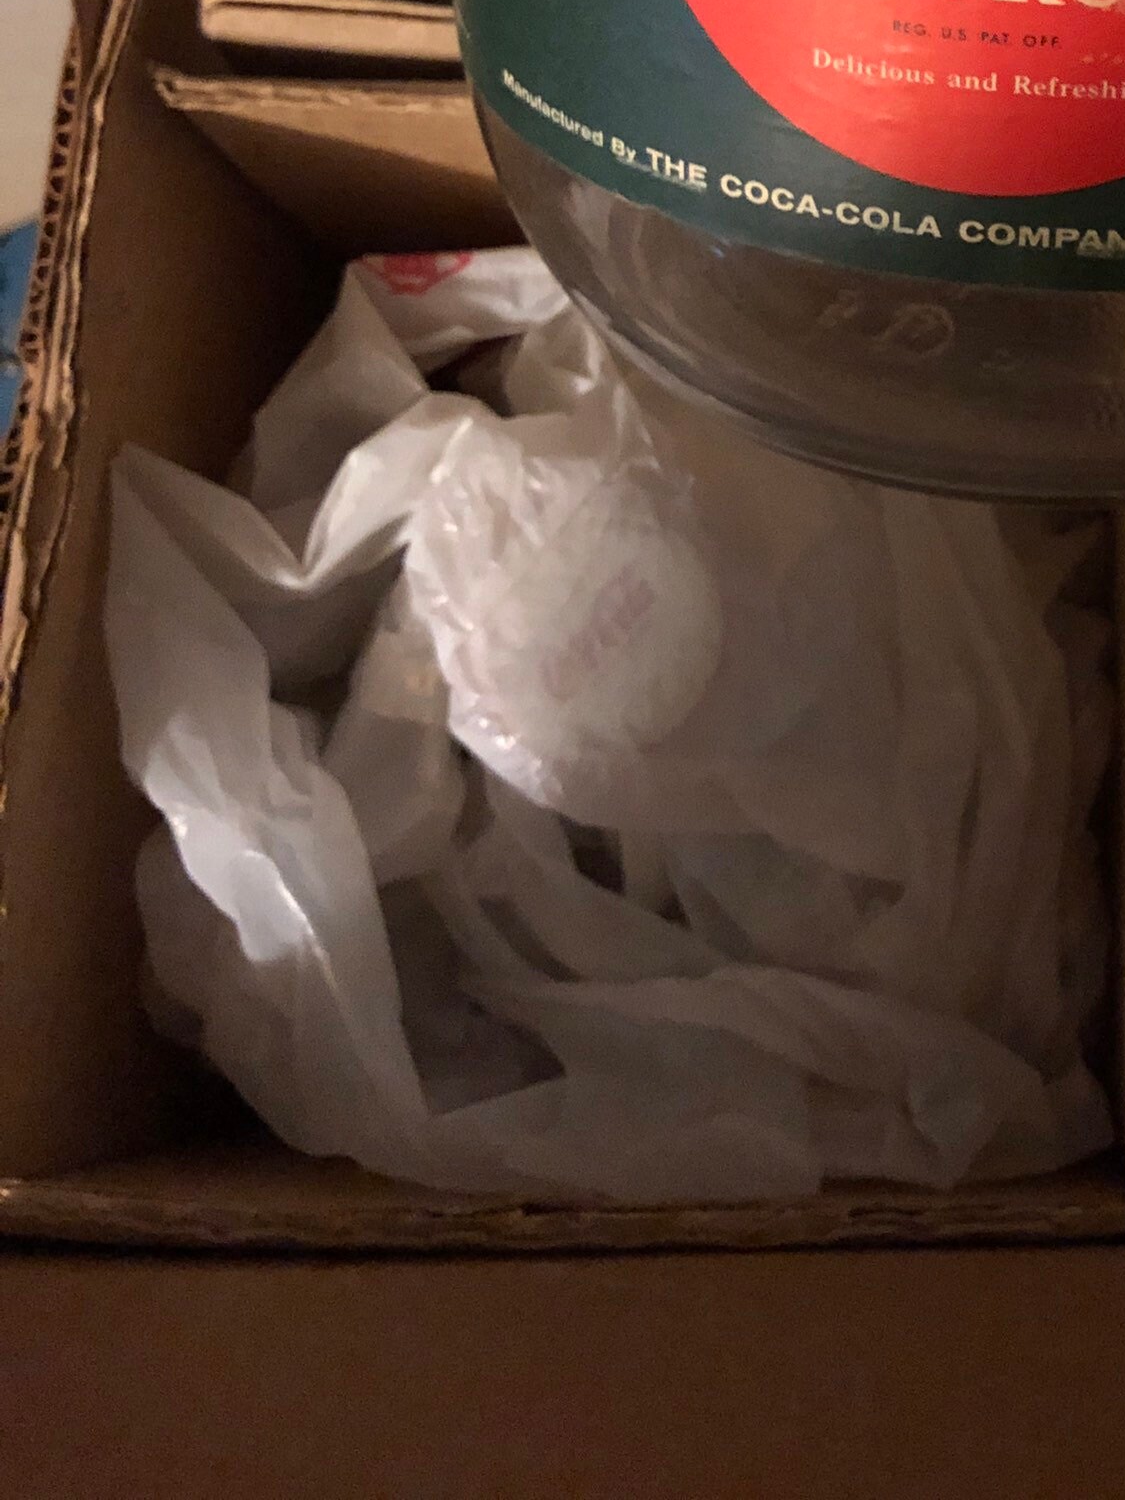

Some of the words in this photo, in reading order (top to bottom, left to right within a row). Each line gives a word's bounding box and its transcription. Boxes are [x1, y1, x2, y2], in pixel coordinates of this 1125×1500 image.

[812, 47, 936, 85] Delicious
[946, 72, 999, 94] and
[501, 67, 604, 148] Manufactured
[610, 135, 637, 164] By
[645, 146, 708, 186] THE
[718, 173, 943, 240] COCA-COLA
